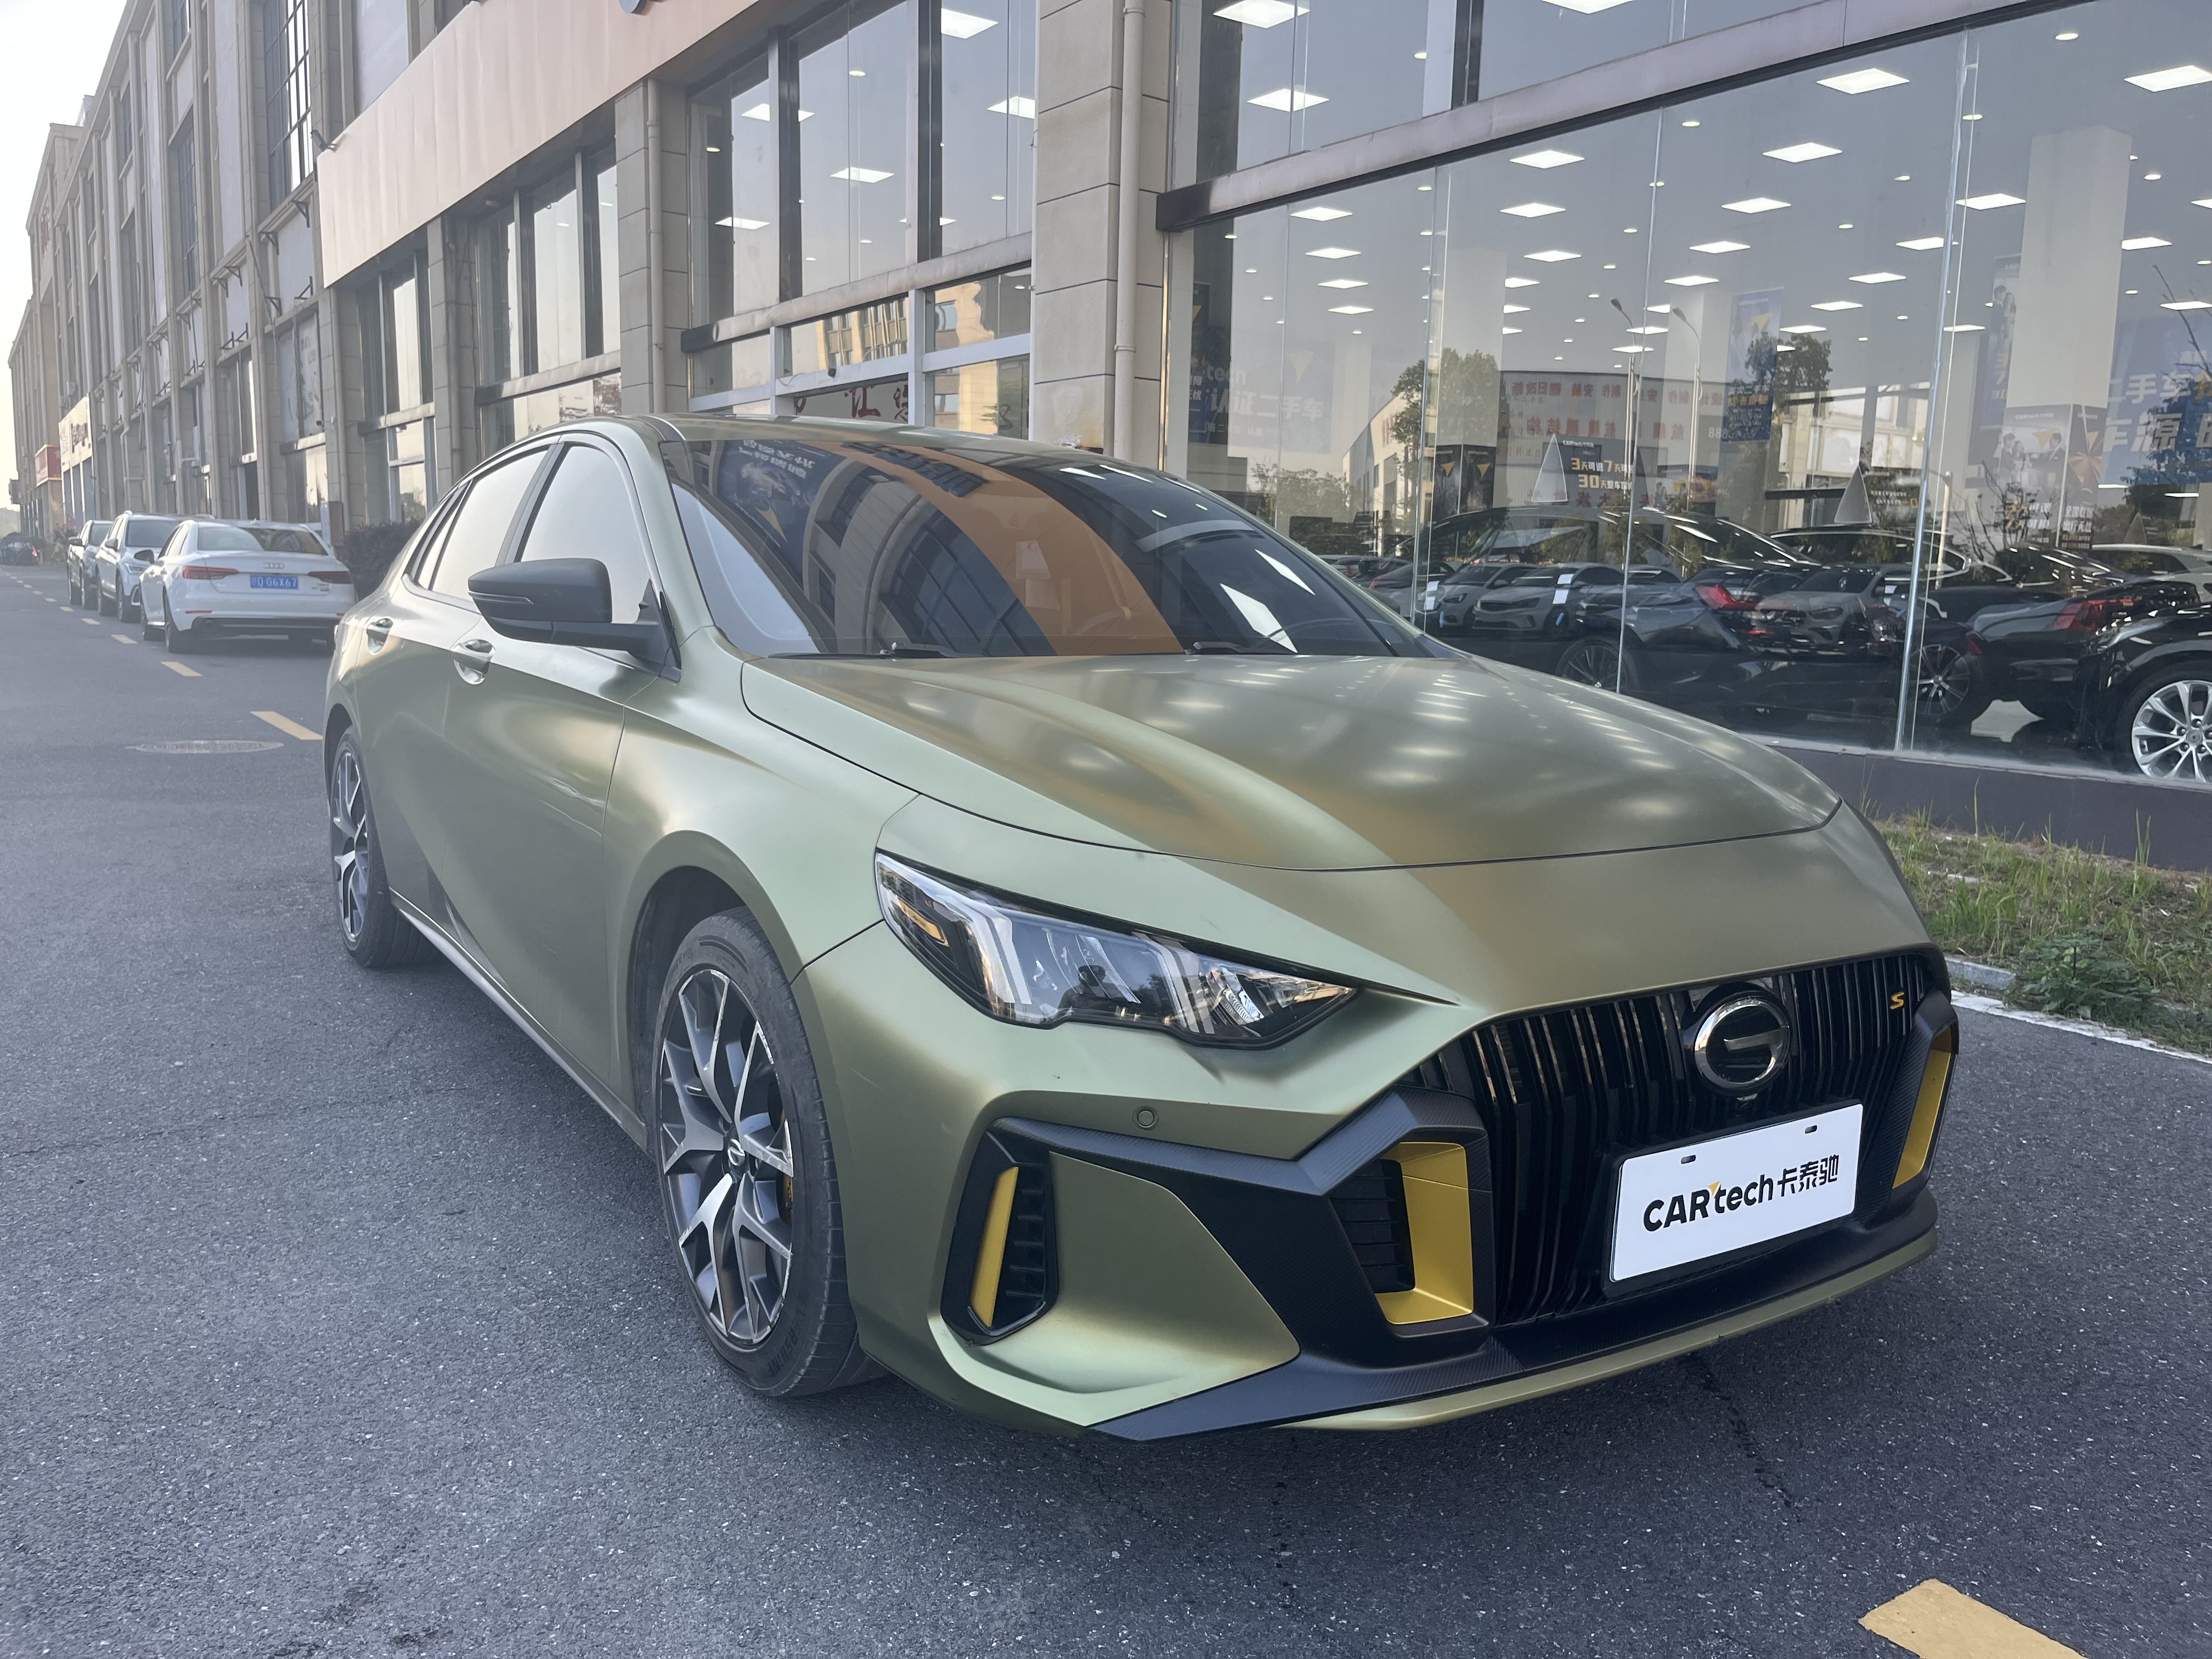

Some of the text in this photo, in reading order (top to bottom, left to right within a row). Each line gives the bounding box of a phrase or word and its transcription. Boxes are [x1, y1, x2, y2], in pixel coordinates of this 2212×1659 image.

[1889, 990, 1905, 1011] S
[1643, 1154, 1839, 1232] CARtech 卡泰驰
